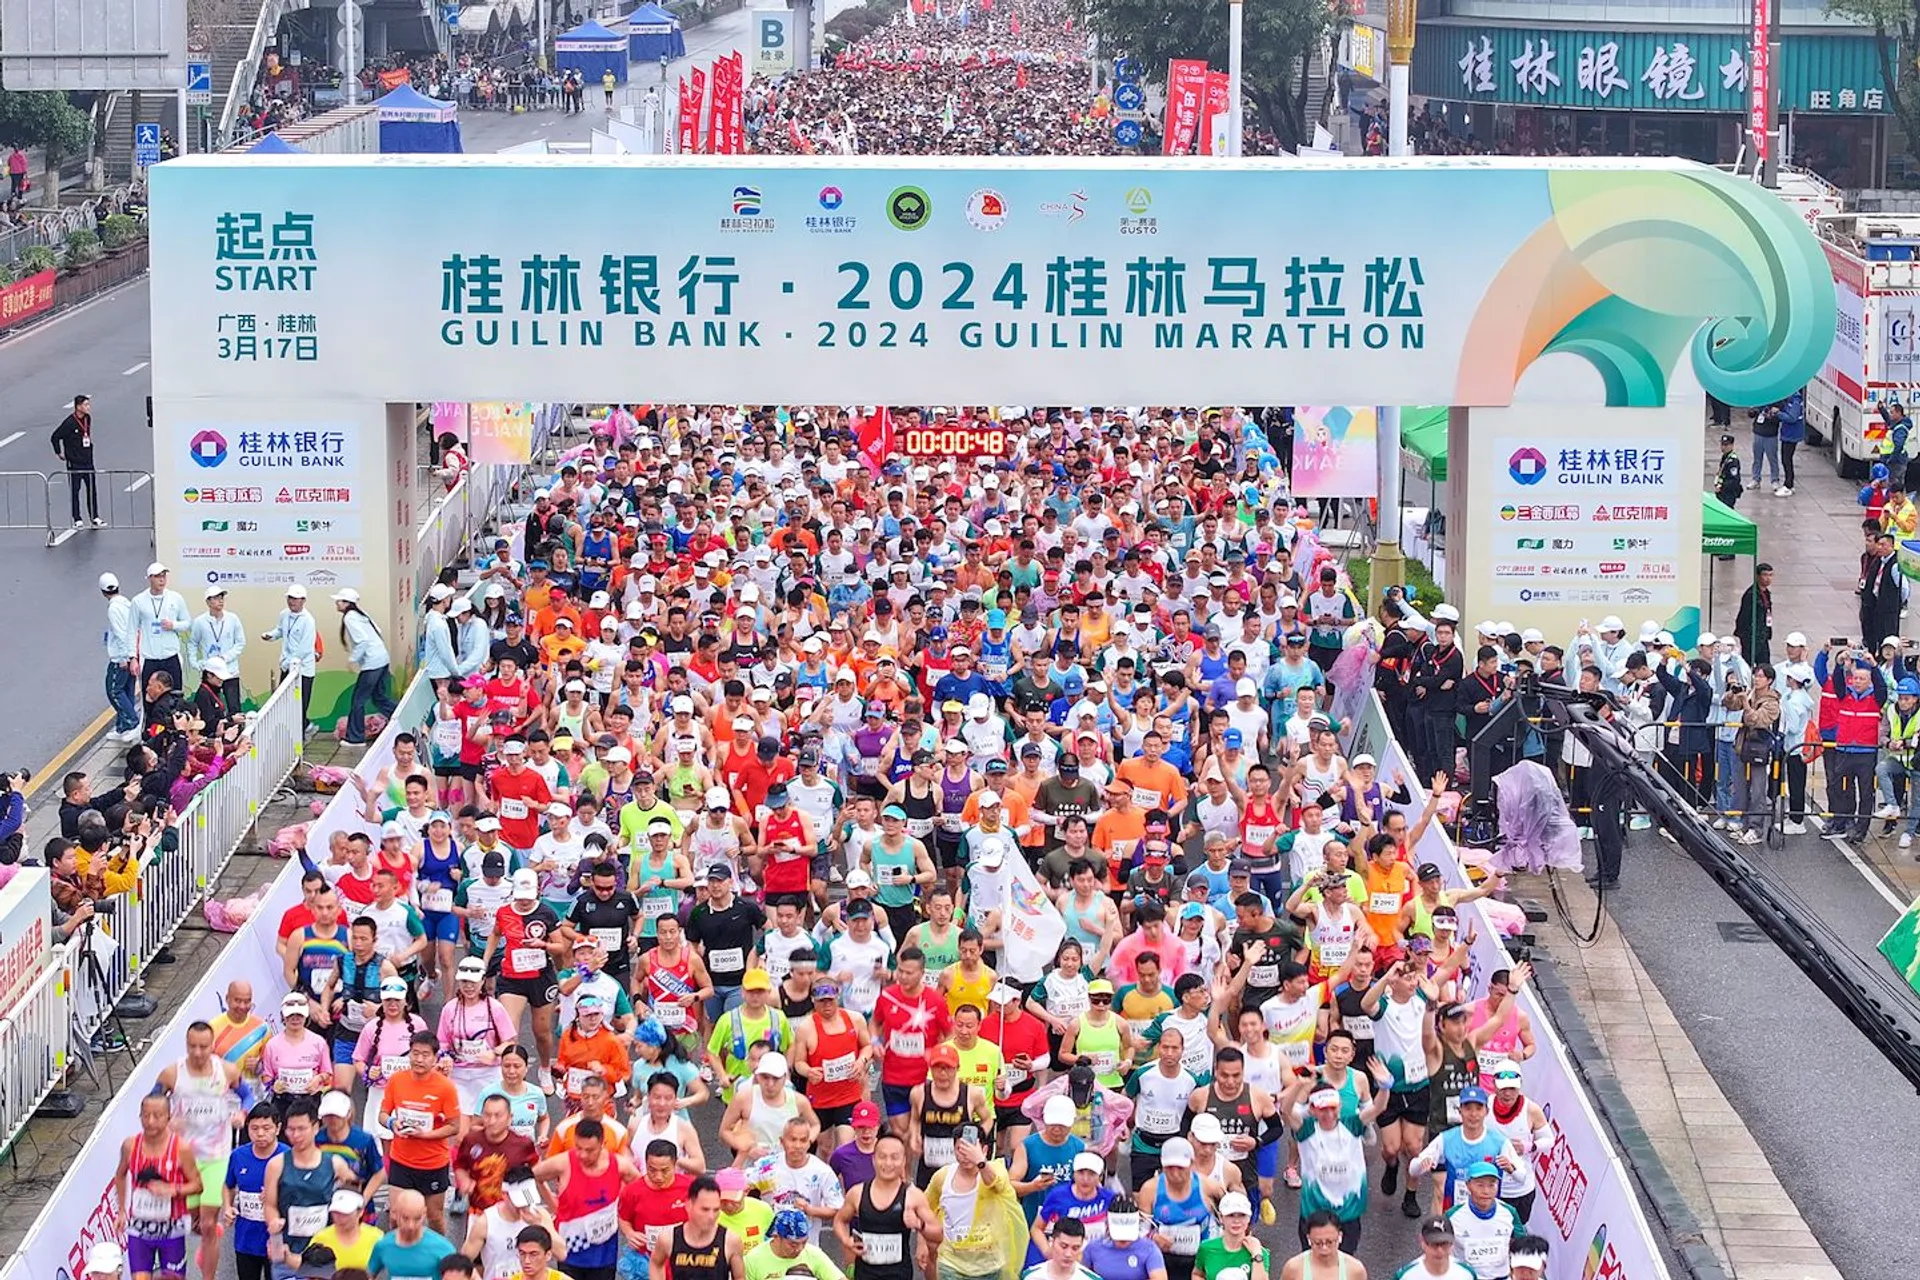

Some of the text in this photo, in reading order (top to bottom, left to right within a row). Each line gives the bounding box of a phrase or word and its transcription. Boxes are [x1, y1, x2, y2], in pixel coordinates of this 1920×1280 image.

[761, 20, 785, 48] B
[1810, 87, 1884, 110] 旺角店
[806, 216, 856, 228] 桂林银行
[1120, 226, 1158, 235] GUSTO
[216, 211, 317, 260] 起点
[215, 265, 317, 291] START
[441, 319, 603, 346] GUILIN
[635, 320, 761, 346] BANK
[817, 321, 929, 348] 2024
[959, 321, 1123, 349] GUILIN
[1155, 322, 1425, 349] MARATHON
[218, 336, 317, 361] 3月17日
[238, 431, 345, 454] 桂林银行
[906, 430, 1004, 454] 00:00:48
[239, 455, 345, 467] GUILIN BANK
[1557, 448, 1665, 471] 桂林银行
[1558, 473, 1664, 485] GUILIN BANK
[295, 488, 350, 503] 匹克体育
[1517, 505, 1580, 521] 三金西瓜霜
[1612, 506, 1668, 520] 匹克体育
[1552, 538, 1574, 549] 魔力
